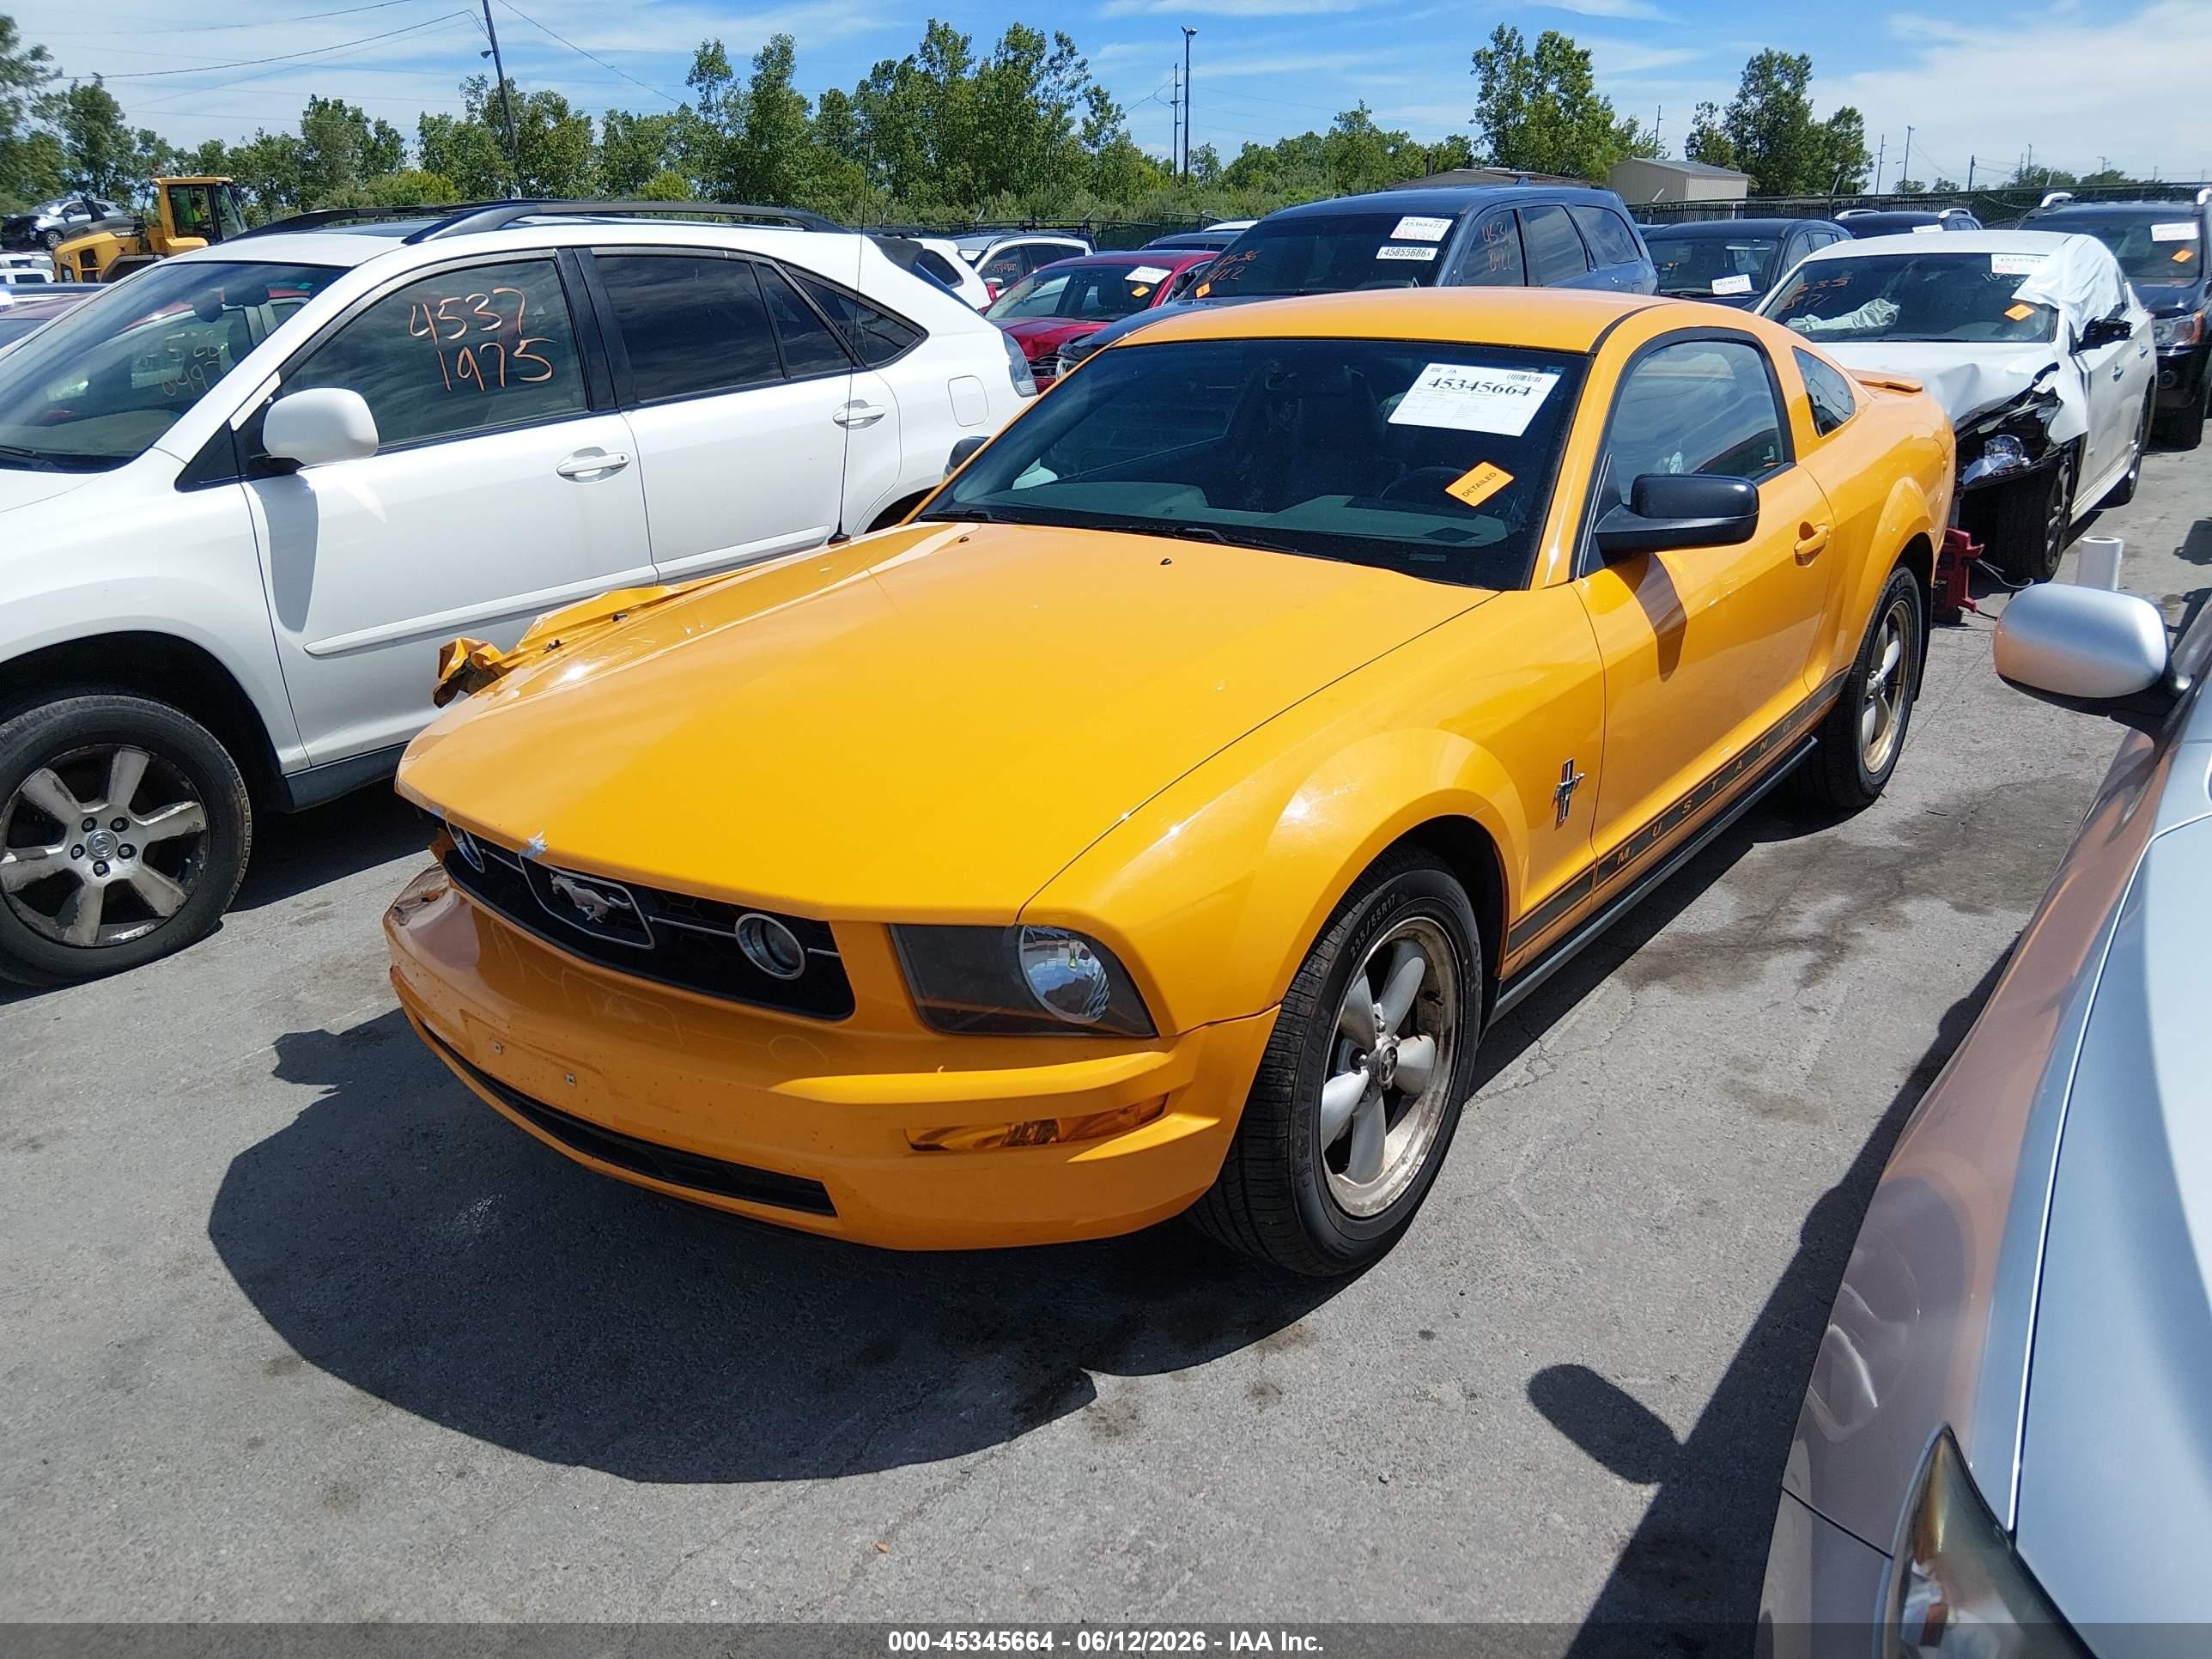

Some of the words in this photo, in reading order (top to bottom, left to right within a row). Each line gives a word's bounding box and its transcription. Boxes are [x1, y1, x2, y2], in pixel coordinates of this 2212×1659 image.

[410, 288, 526, 345] 4537
[437, 338, 557, 392] 1975
[1427, 377, 1532, 396] 45345664
[1462, 471, 1497, 497] DETAILED
[1617, 720, 1792, 866] MUSTANG
